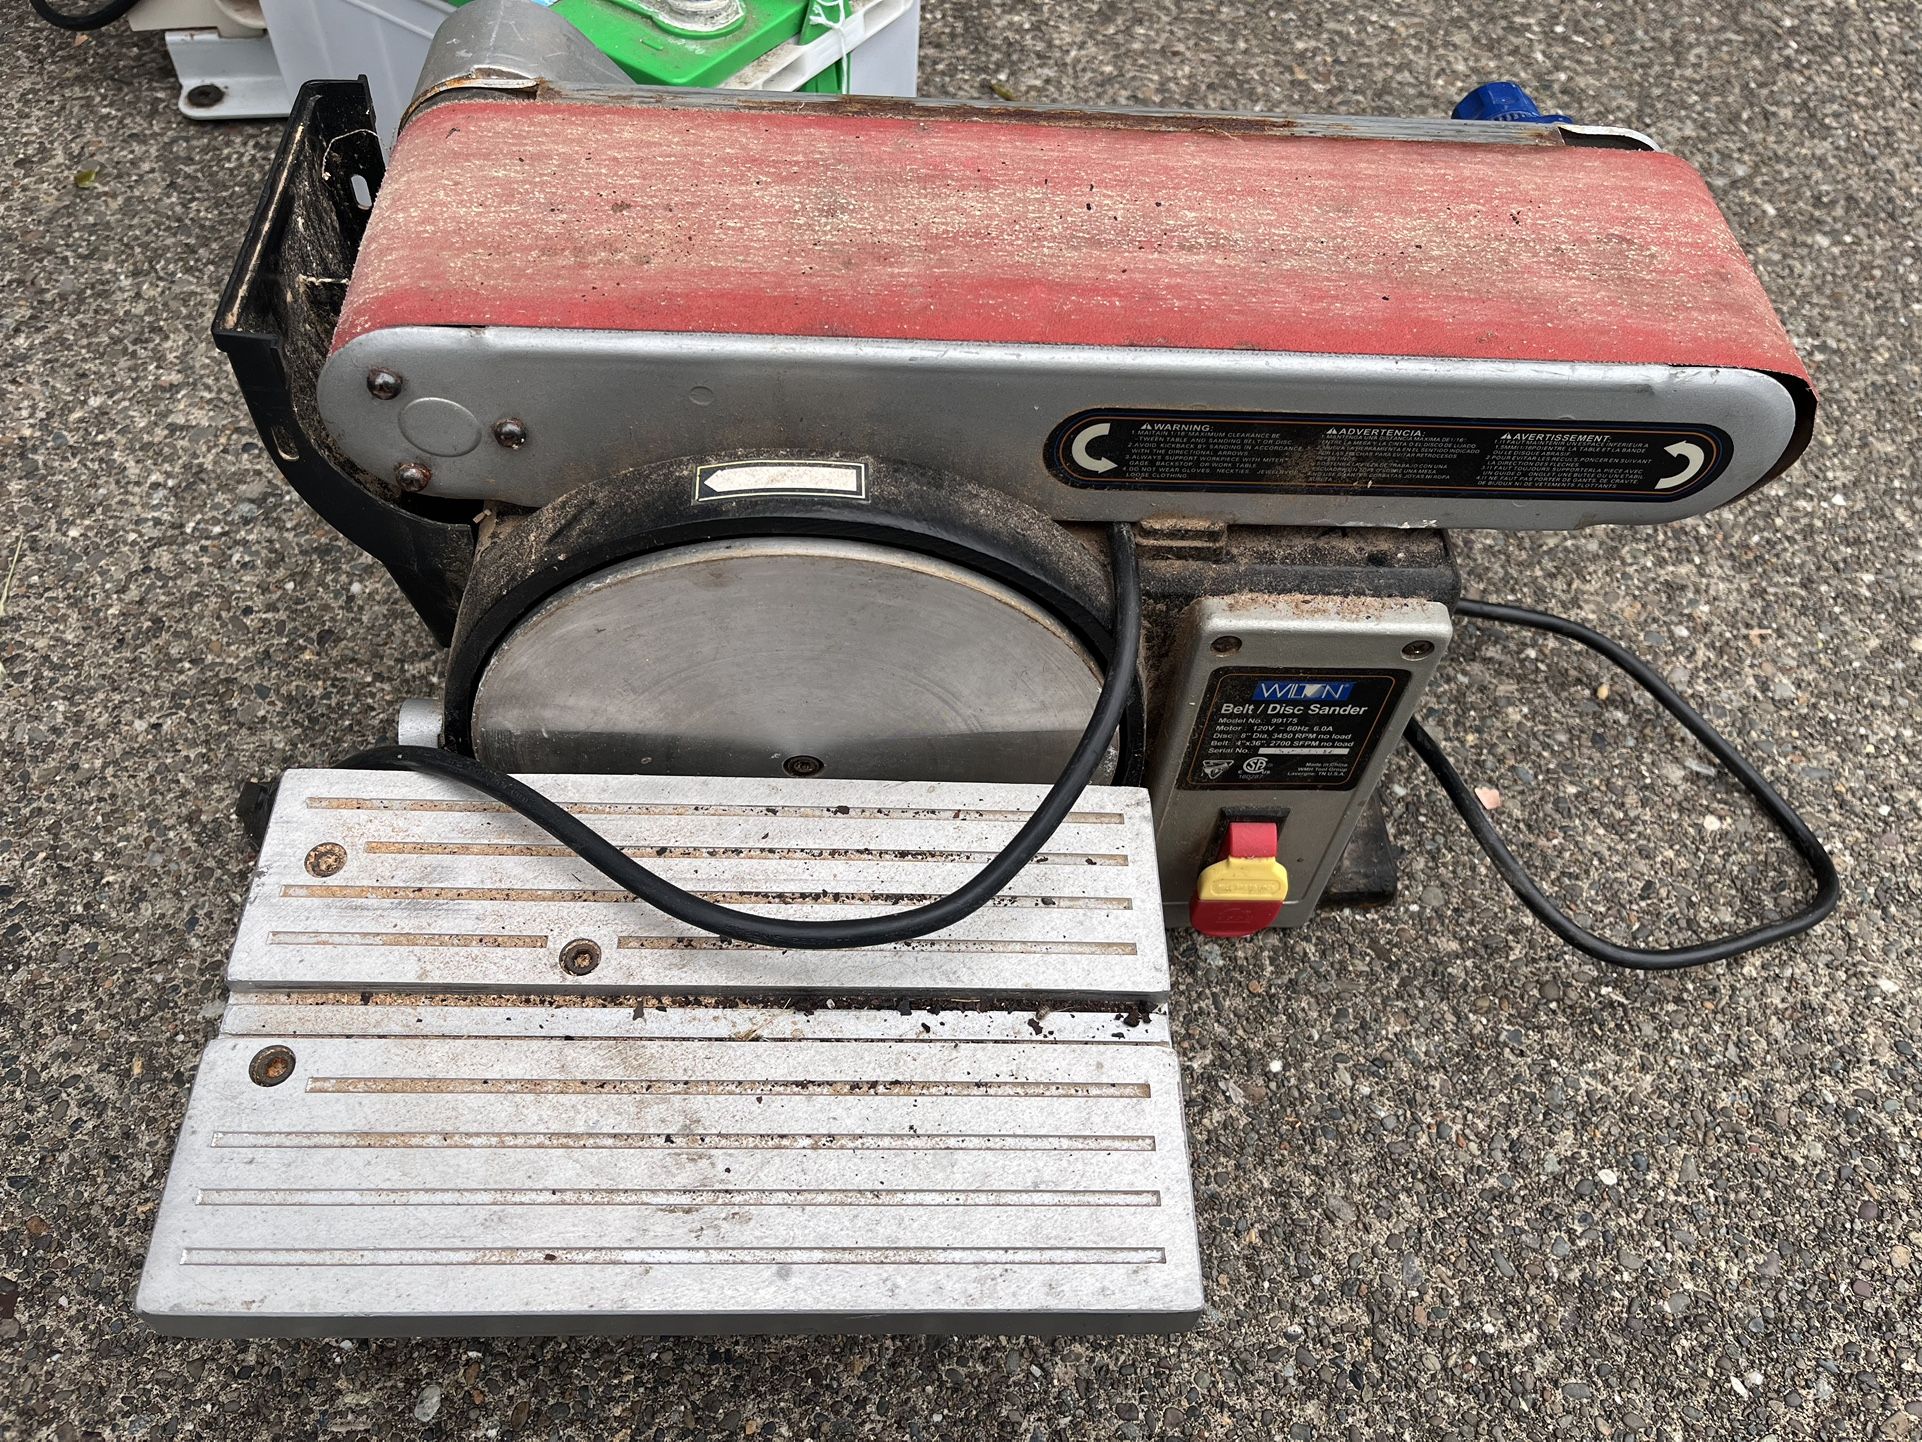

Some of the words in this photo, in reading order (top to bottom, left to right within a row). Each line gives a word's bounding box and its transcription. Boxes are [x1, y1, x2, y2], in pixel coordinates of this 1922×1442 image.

[1338, 428, 1426, 437] ADVERTENCIA:
[1513, 433, 1612, 442] AVERTISSEMENT:
[1221, 703, 1255, 714] Belt
[1256, 704, 1265, 714] /
[1267, 704, 1304, 714] Disc
[1308, 704, 1368, 715] Sander
